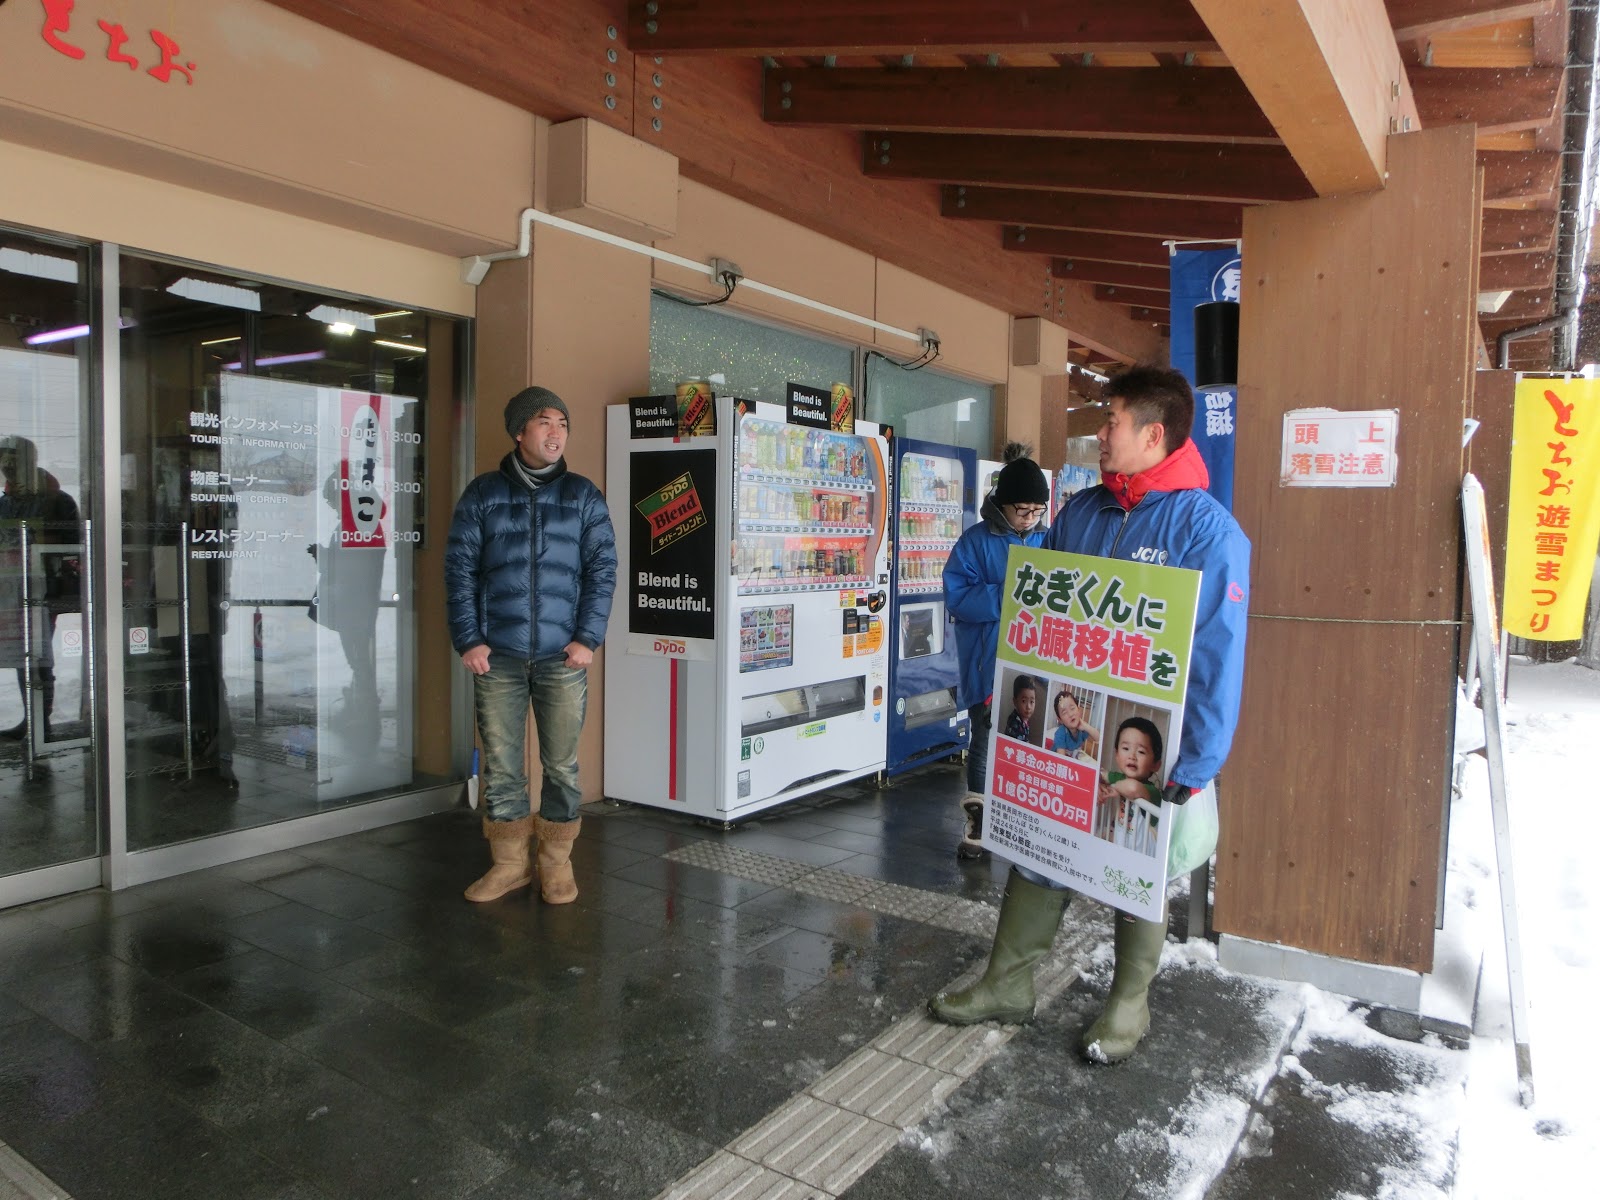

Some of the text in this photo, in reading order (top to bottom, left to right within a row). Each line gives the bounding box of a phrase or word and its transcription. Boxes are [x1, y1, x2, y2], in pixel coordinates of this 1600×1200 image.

[685, 394, 704, 422] Blend
[793, 391, 814, 404] Blend
[815, 396, 822, 406] is
[635, 406, 667, 416] Blend is
[793, 406, 828, 421] Beautiful.
[190, 411, 322, 435] 観光インフォメーション
[636, 418, 675, 428] Beautiful.
[190, 434, 306, 450] TOURIST INFORMATION
[1291, 453, 1384, 475] 落雪注意
[190, 471, 272, 486] 物産コーナー
[191, 493, 288, 504] SOUVENIR CORNER
[660, 476, 689, 502] DyDo
[654, 494, 697, 531] Blend
[192, 529, 304, 543] レストランコーナー
[658, 515, 703, 546] ダイドーブレンド
[191, 550, 258, 559] RESTAURANT
[1131, 546, 1156, 562] JCI
[638, 572, 698, 589] Blend is
[638, 594, 711, 612] Beautiful.
[1012, 564, 1166, 630] なぎくんに
[654, 638, 686, 655] DyDo
[1007, 610, 1177, 687] 心臓移植を
[1016, 749, 1079, 782] 募金のお願い
[1018, 770, 1064, 796] 募金目標金額
[997, 774, 1088, 826] 1億6500万円
[991, 799, 1040, 825] 新潟県長岡市在住の
[990, 814, 1029, 838] 平成24年5月に
